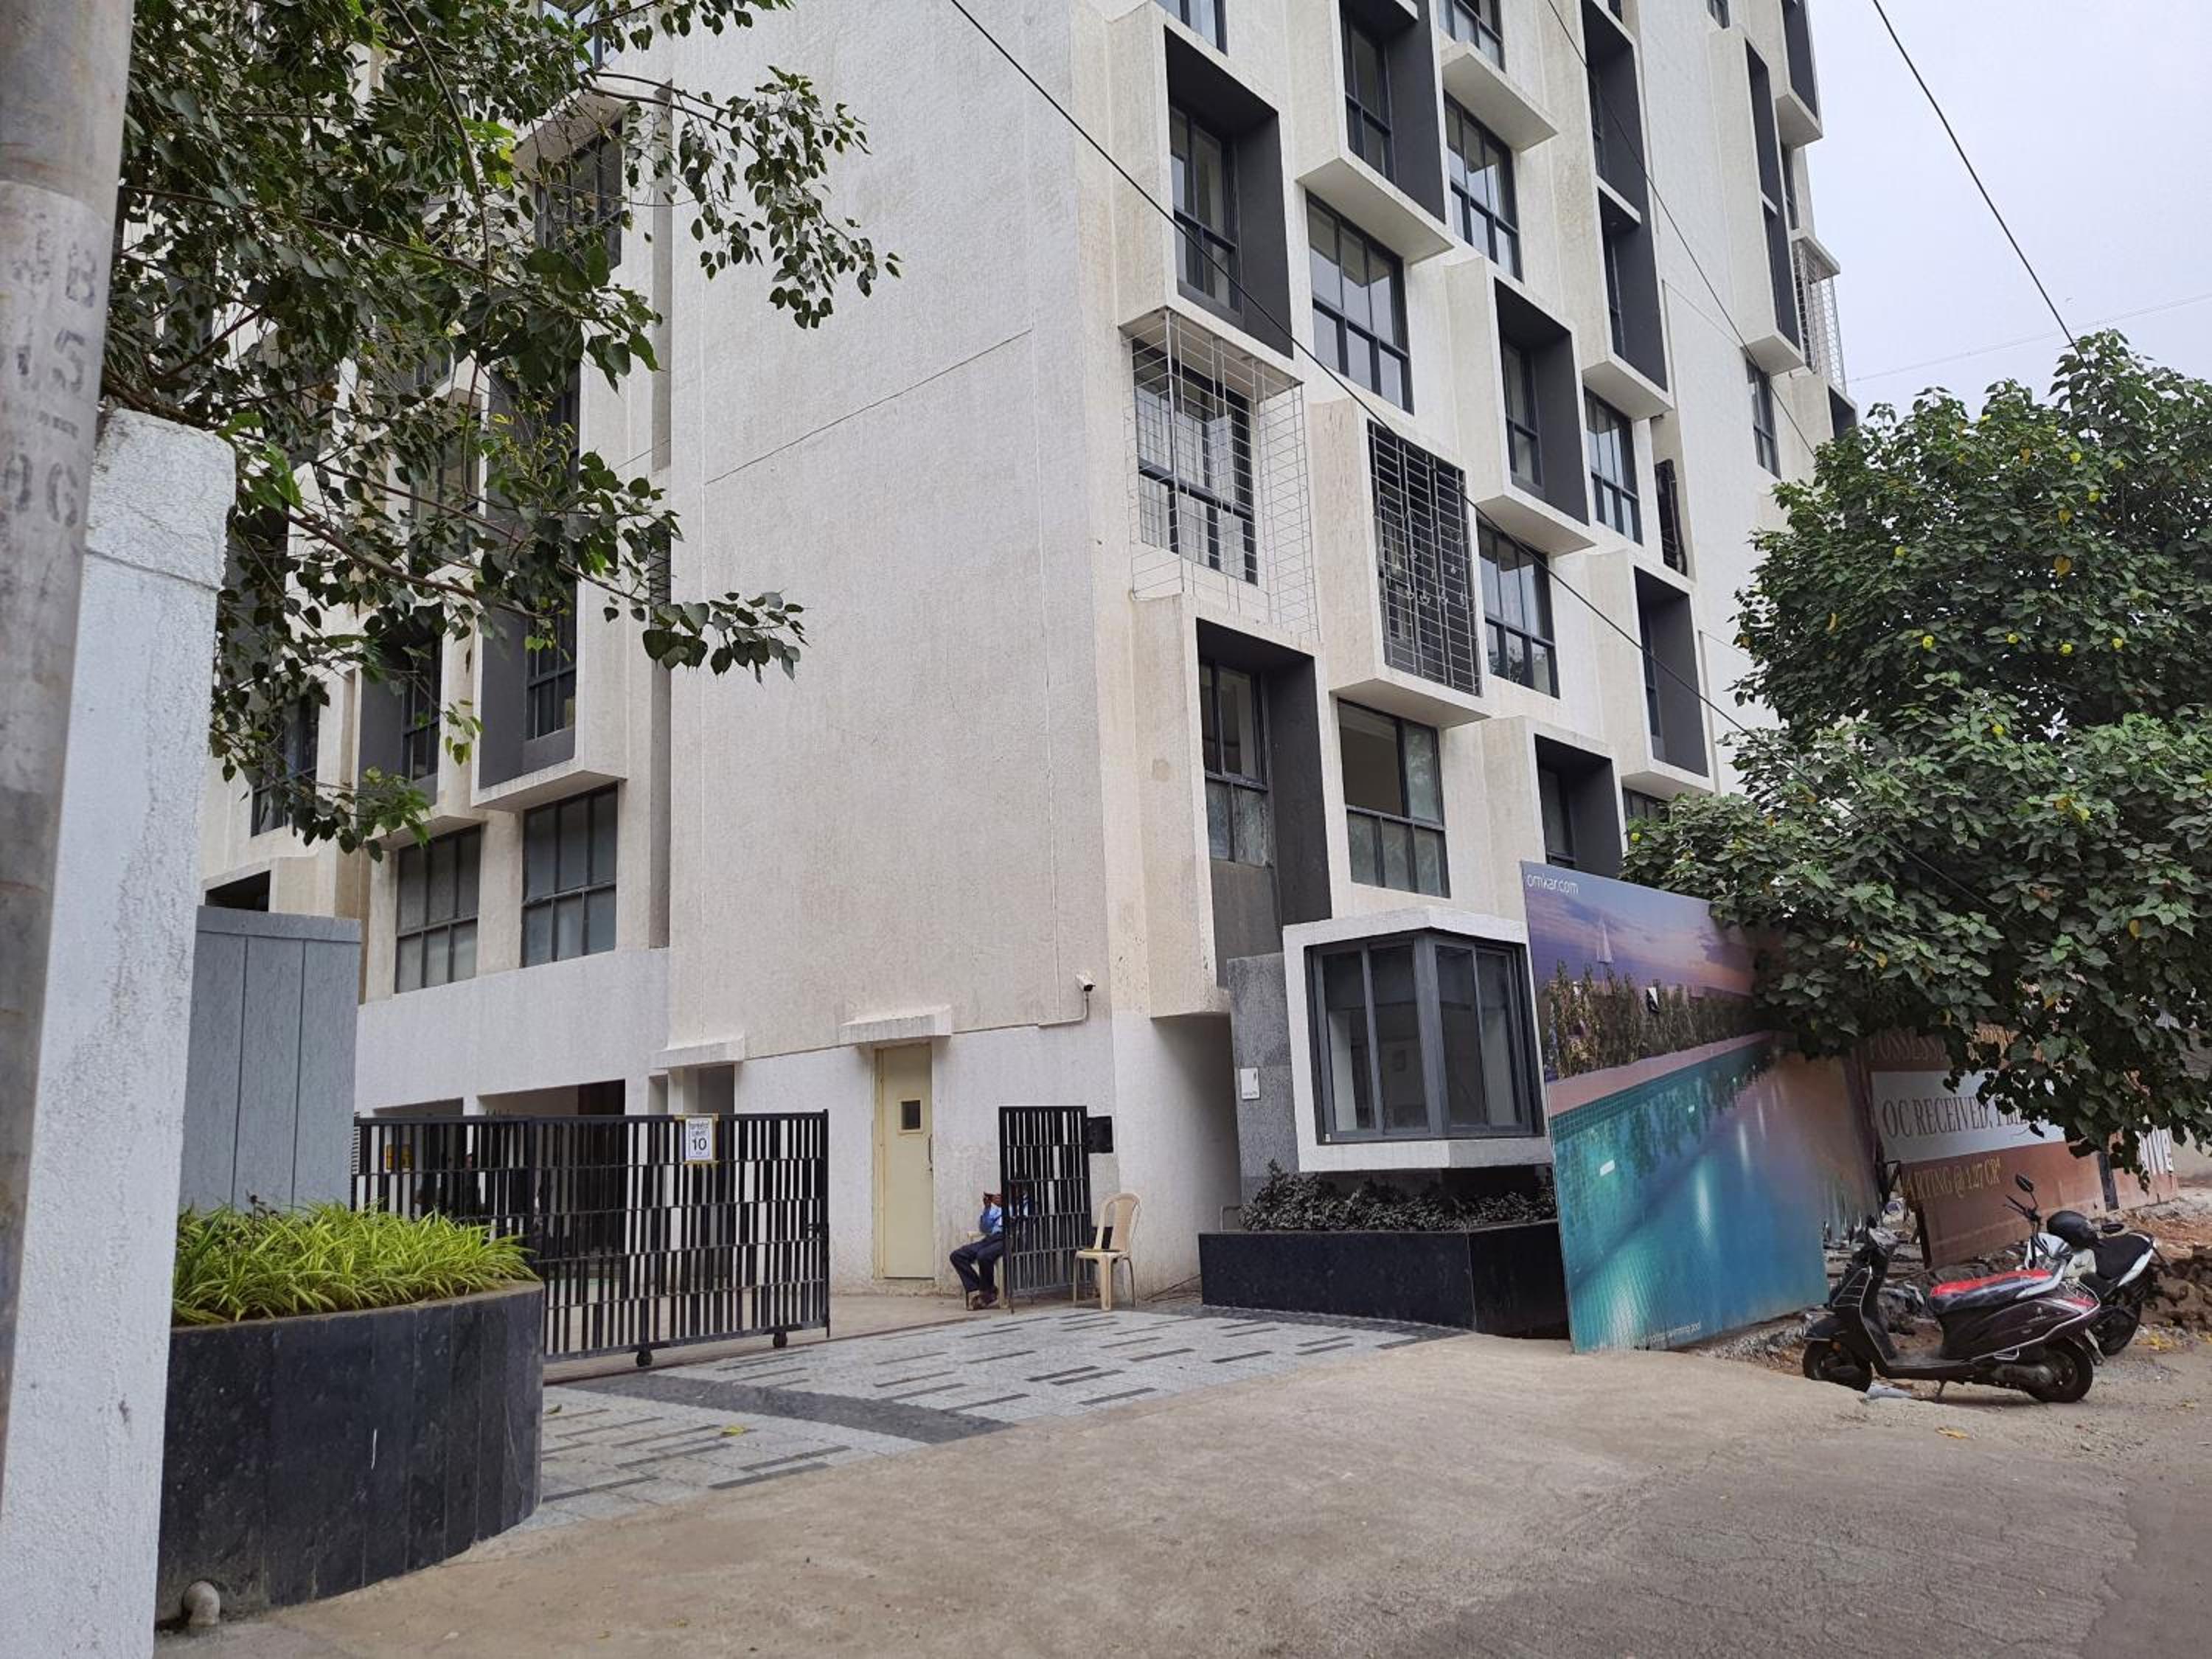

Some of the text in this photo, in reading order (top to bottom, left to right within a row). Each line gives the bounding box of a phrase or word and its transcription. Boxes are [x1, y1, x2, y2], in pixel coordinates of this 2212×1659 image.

[1526, 873, 1579, 895] omkar.com
[1882, 1099, 1912, 1138] OC
[692, 1138, 707, 1151] 10
